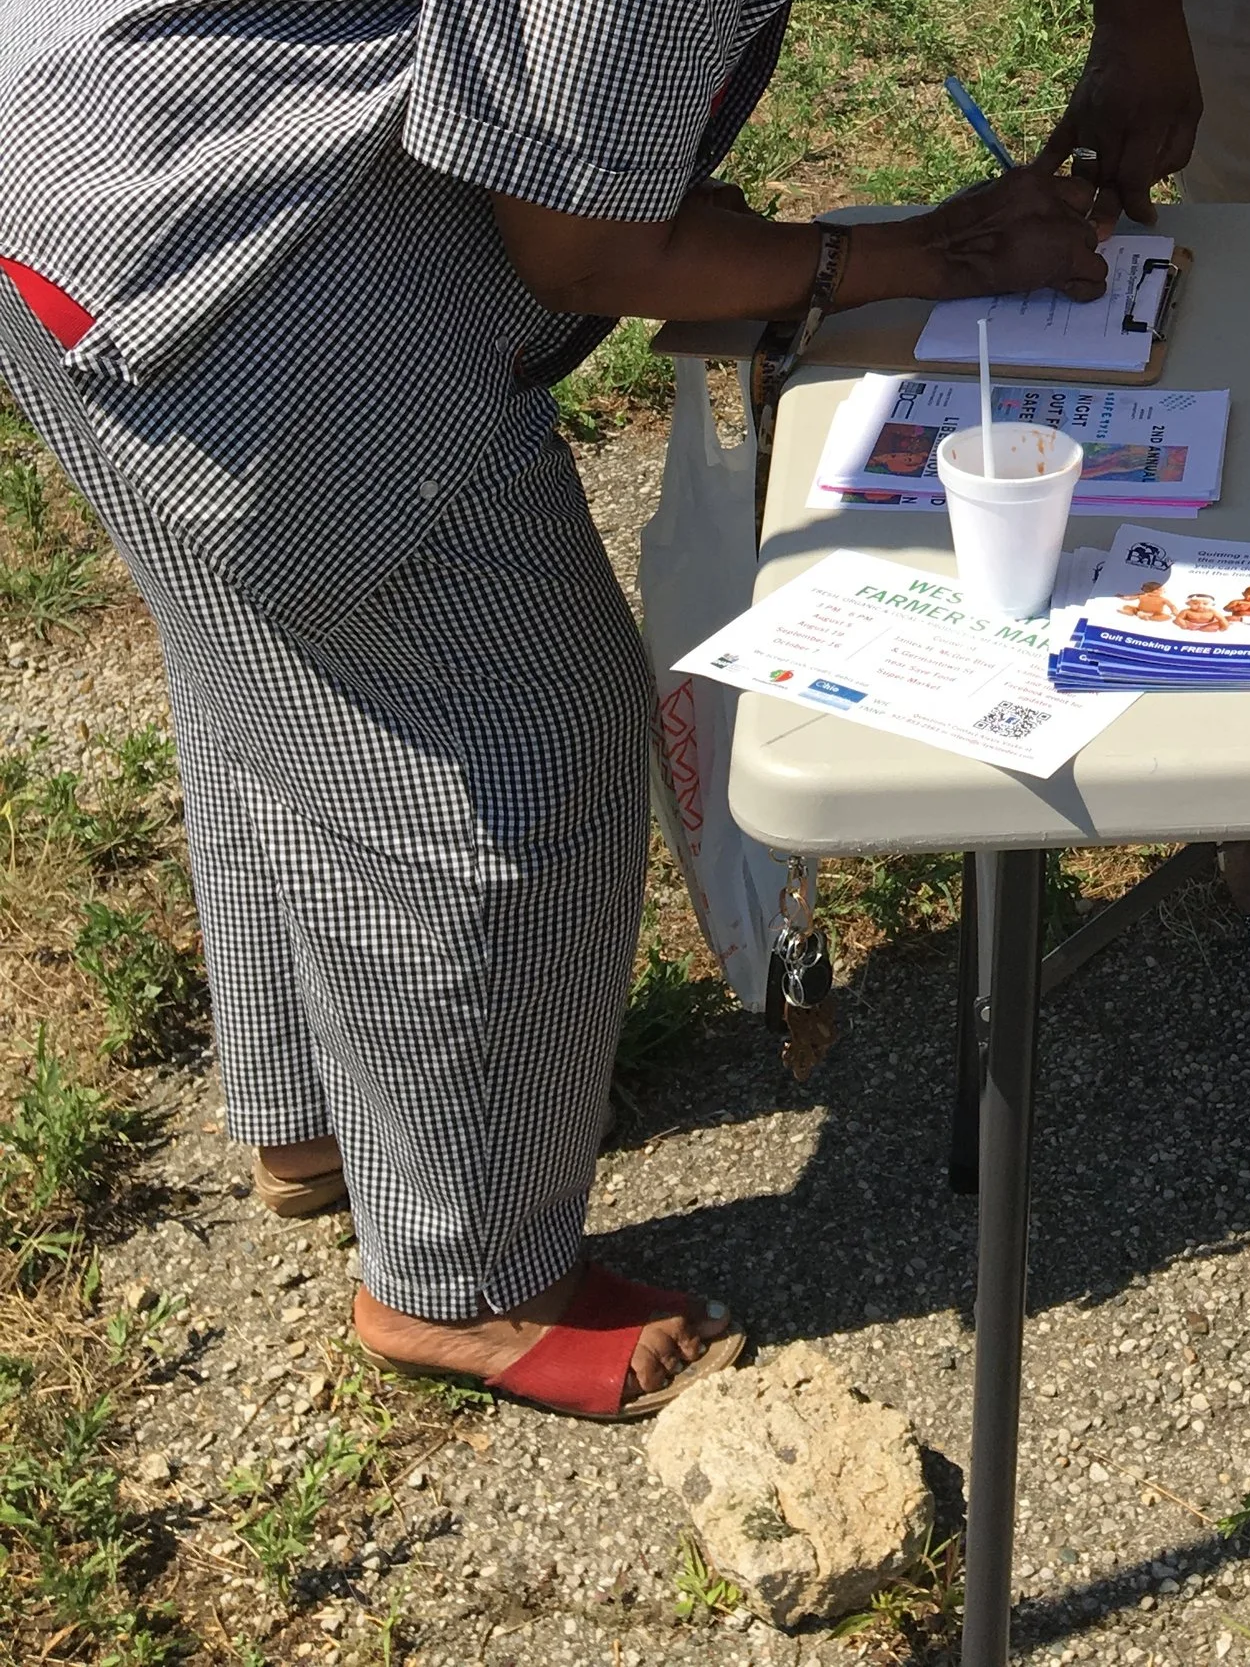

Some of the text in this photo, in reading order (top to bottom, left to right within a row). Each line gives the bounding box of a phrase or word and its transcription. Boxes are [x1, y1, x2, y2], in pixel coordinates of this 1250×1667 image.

[1047, 394, 1066, 415] OUT
[1072, 394, 1093, 427] NIGHT
[1141, 425, 1165, 483] 2ND ANNUAL
[908, 580, 964, 604] WES
[855, 585, 991, 632] FARMER'S
[797, 620, 830, 634] August
[812, 613, 844, 627] August
[772, 638, 810, 653] October
[776, 626, 842, 649] September 16
[894, 636, 924, 650] James
[1100, 631, 1123, 642] Quit
[1125, 636, 1172, 652] Smoking
[1180, 645, 1211, 655] FREE
[884, 658, 906, 668] near
[902, 650, 960, 672] Germantown
[815, 680, 840, 694] Ohio
[876, 668, 941, 692] Super Market
[1004, 681, 1044, 696] Facebook
[1045, 694, 1070, 705] event
